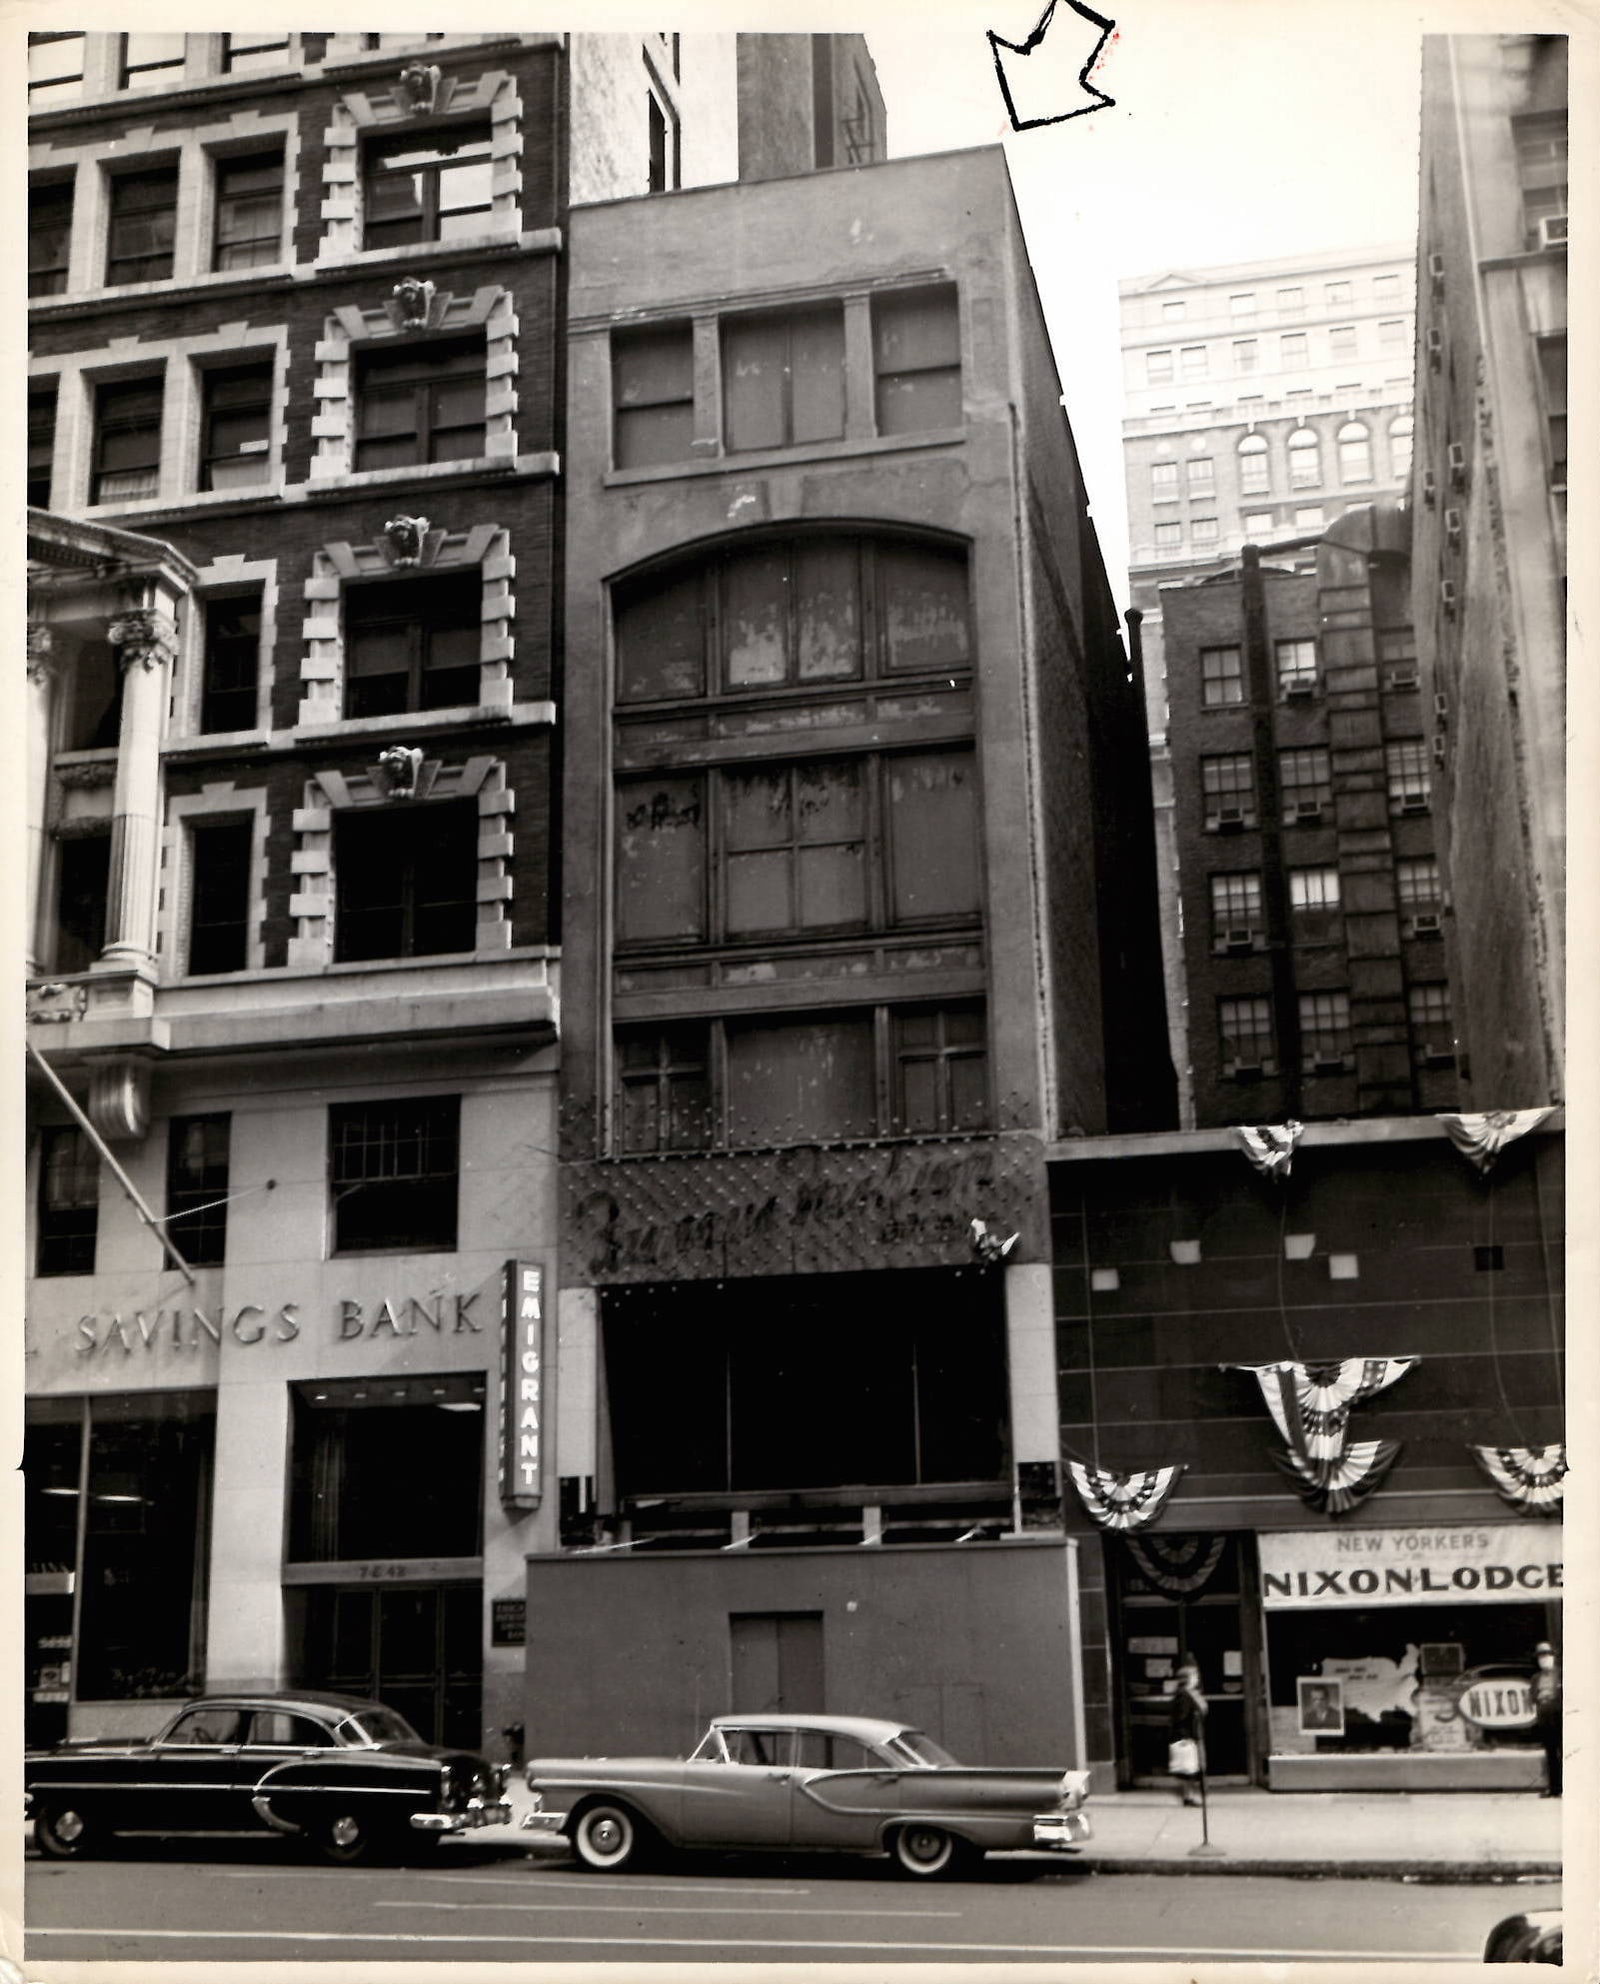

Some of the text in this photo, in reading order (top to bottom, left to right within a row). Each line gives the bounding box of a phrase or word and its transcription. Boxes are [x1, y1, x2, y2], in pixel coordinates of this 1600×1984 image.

[74, 1293, 483, 1354] SAVINGS BANK
[520, 1270, 541, 1485] EMIGRANT
[1337, 1533, 1490, 1553] NEW YORKERS
[1264, 1563, 1563, 1597] NIXON LODGE
[1469, 1688, 1534, 1718] NIXON
